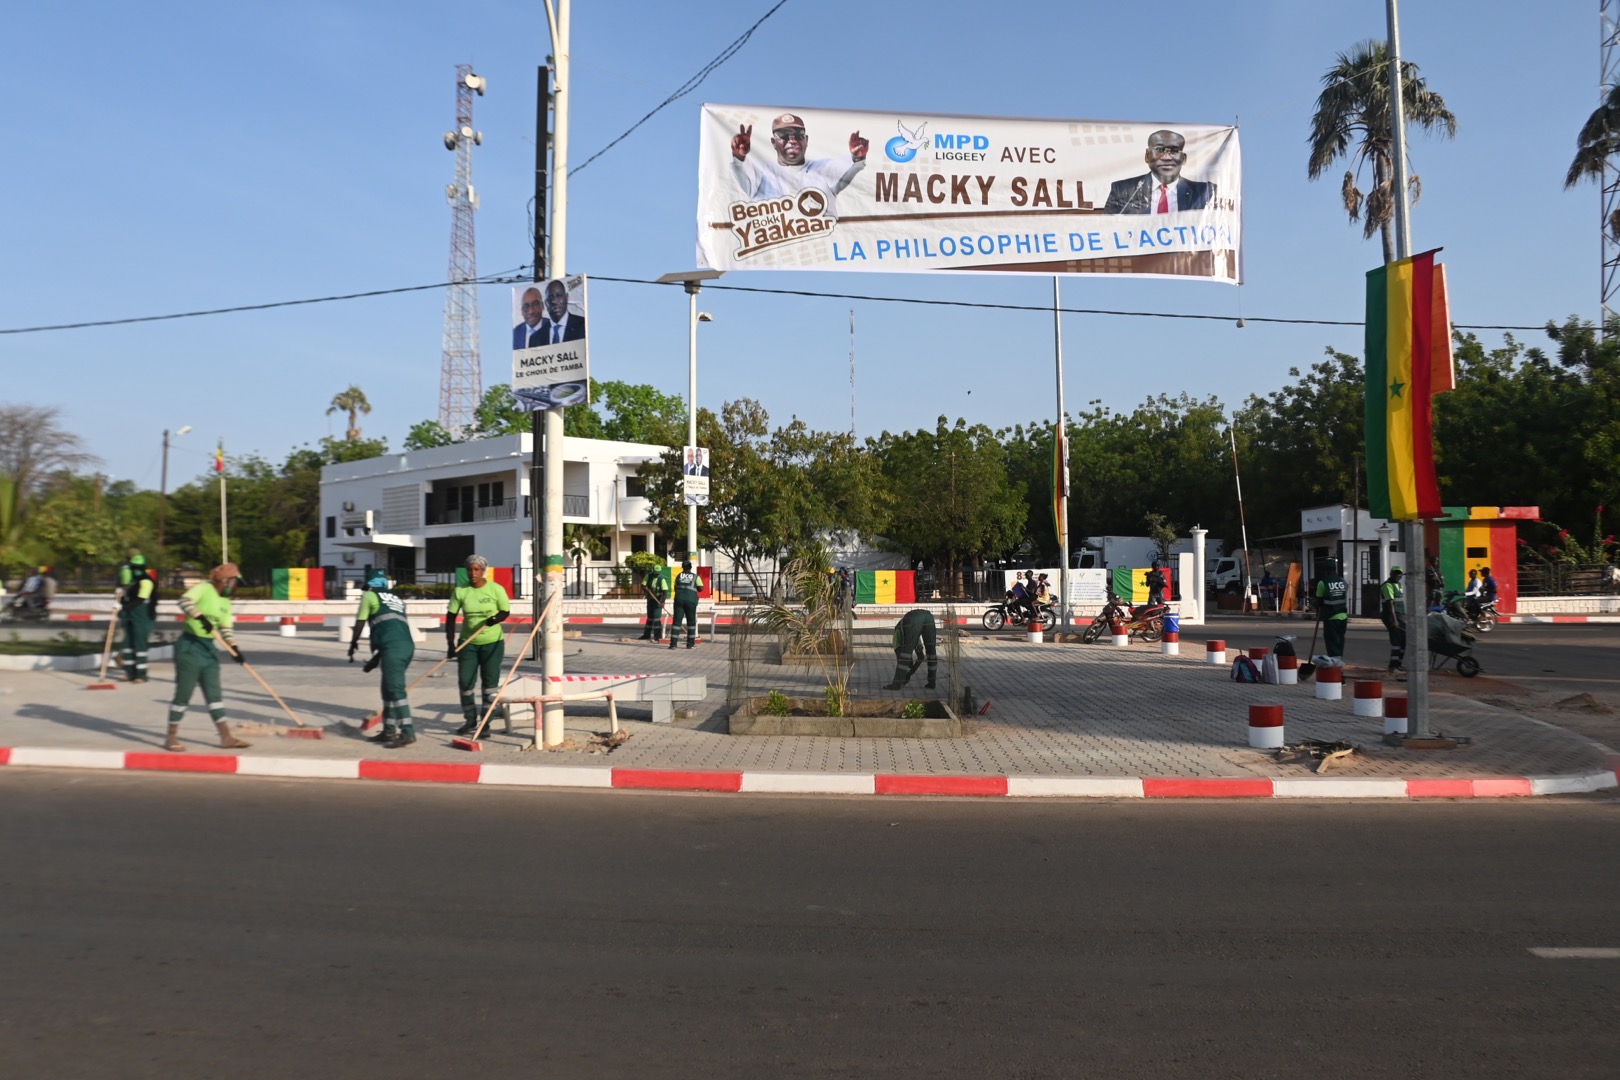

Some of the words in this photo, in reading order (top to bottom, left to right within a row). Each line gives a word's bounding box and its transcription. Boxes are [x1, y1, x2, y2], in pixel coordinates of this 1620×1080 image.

[934, 133, 989, 151] MPD
[935, 151, 987, 162] LIGGEEY
[1000, 146, 1057, 164] AVEC
[875, 172, 996, 205] MACKY
[1010, 175, 1094, 210] SALL
[731, 198, 794, 222] Benno
[735, 212, 834, 249] Yaakaar
[832, 240, 867, 262] LA
[876, 232, 1059, 260] PHILOSOPHIE
[1069, 231, 1104, 252] DE
[520, 354, 554, 368] MACKY
[556, 351, 578, 363] SALL
[516, 370, 524, 378] LE
[525, 367, 547, 377] CHOIX
[549, 365, 559, 374] DE
[560, 362, 584, 372] TAMBA
[1327, 581, 1346, 591] UCG
